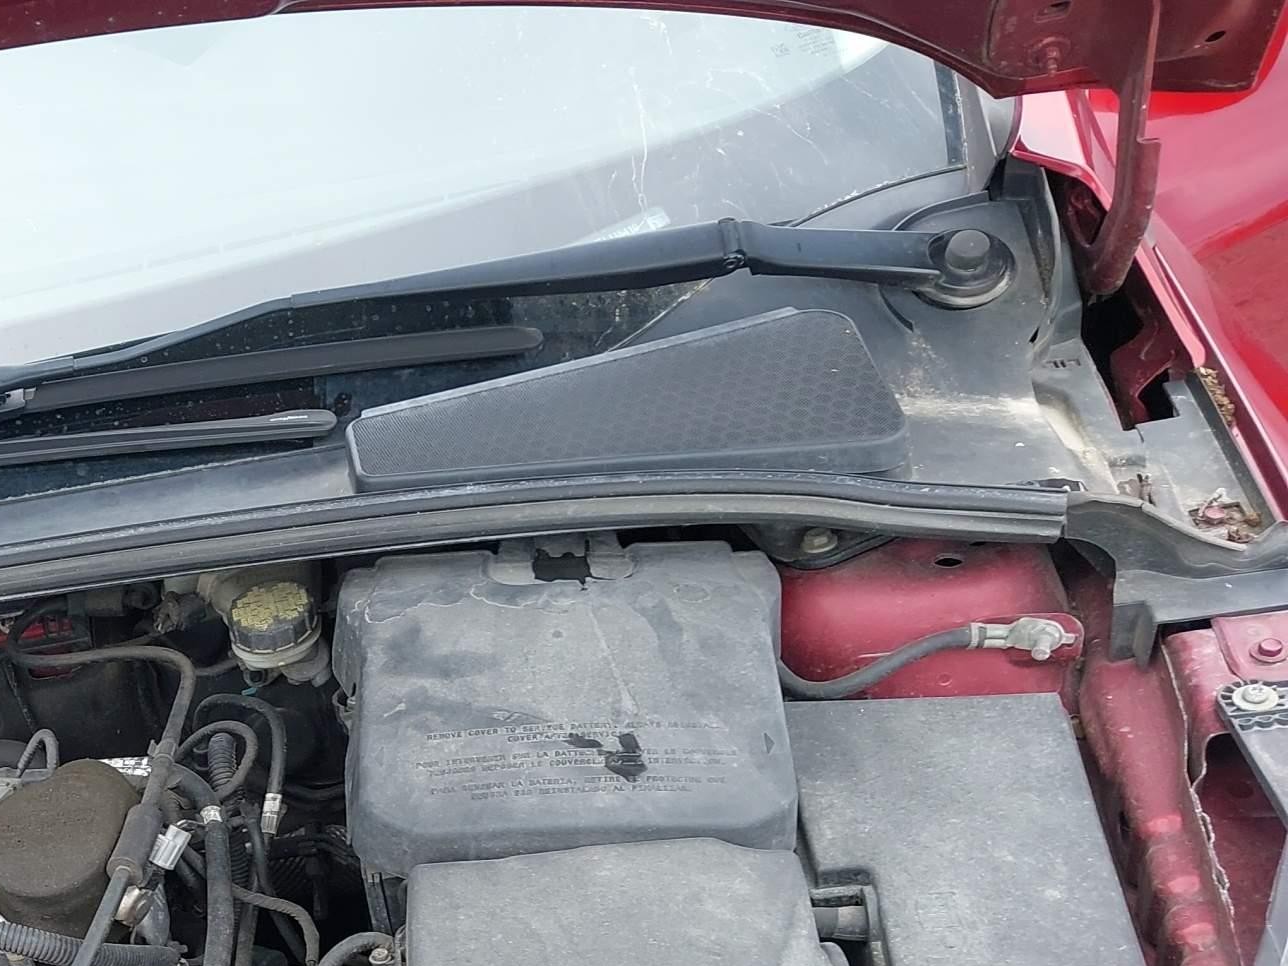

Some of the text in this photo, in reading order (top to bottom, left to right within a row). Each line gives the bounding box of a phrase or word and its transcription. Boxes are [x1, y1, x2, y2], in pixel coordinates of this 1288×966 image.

[426, 731, 463, 741] REMOVE
[467, 728, 499, 738] COVER
[505, 726, 517, 734] TO
[507, 734, 538, 743] COVER
[536, 751, 549, 760] LA
[511, 780, 523, 788] LA
